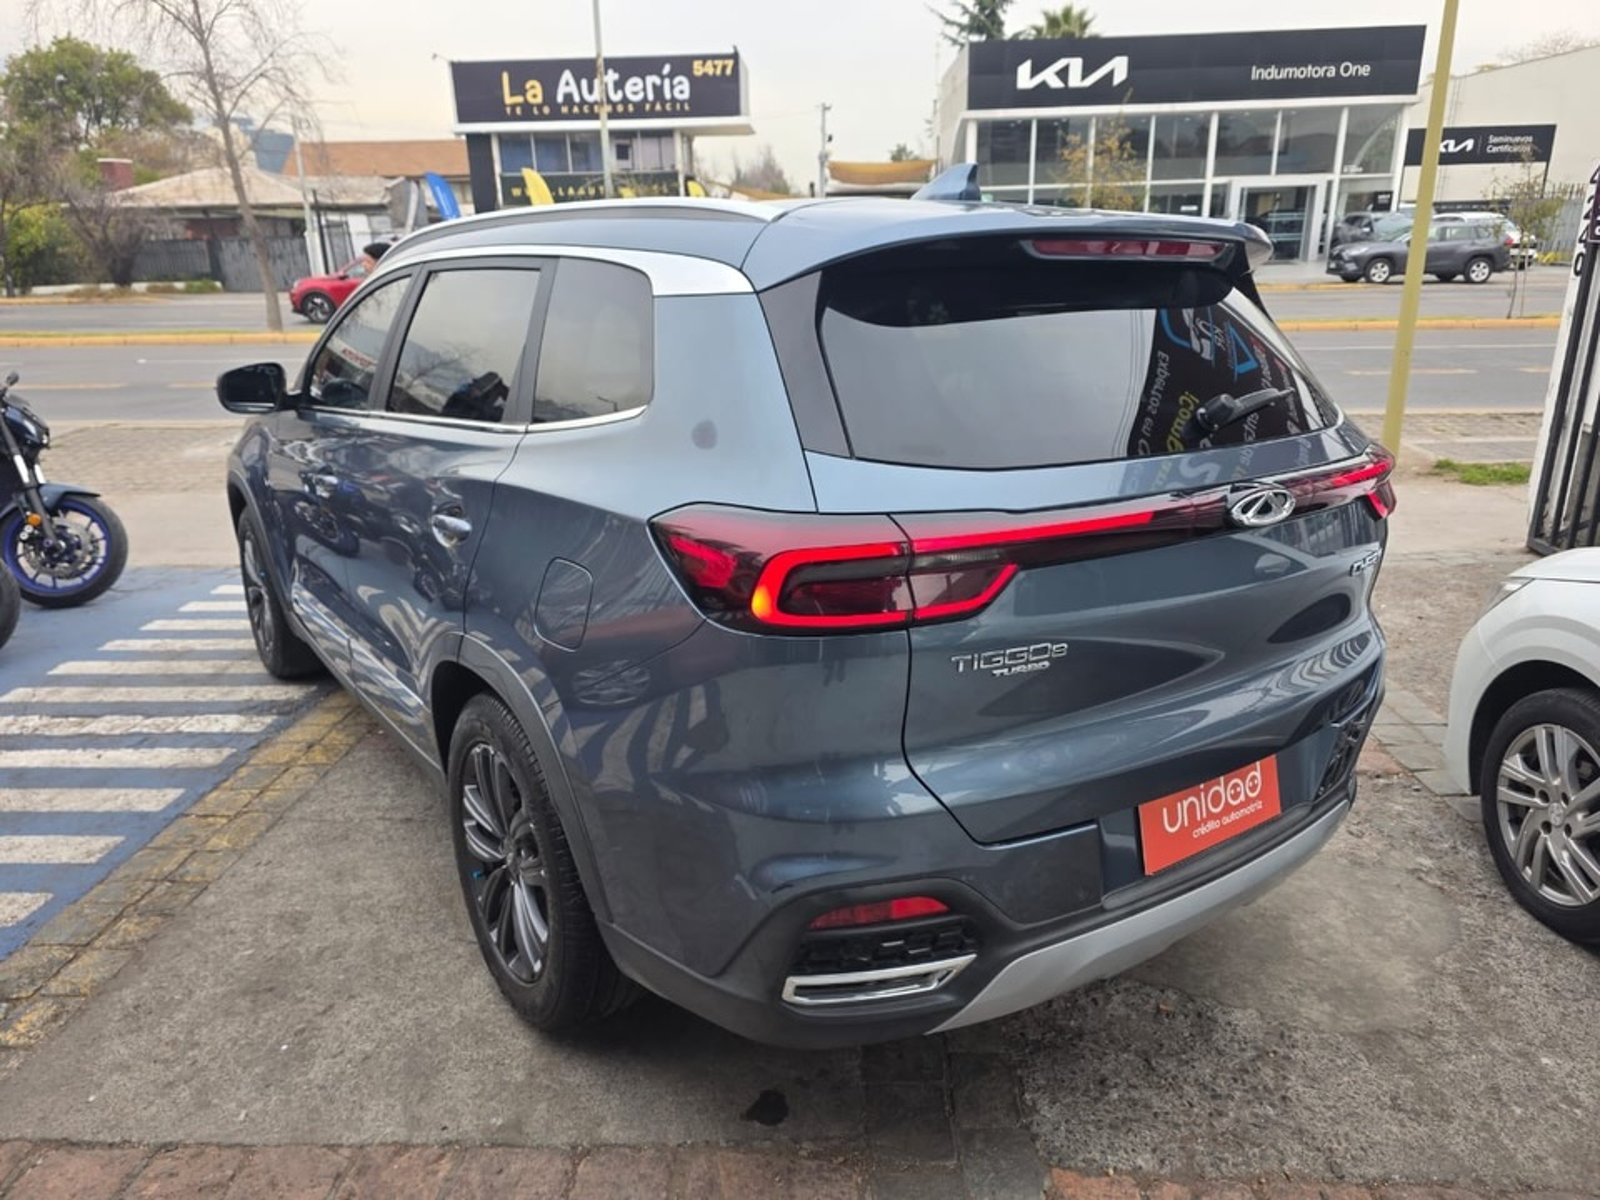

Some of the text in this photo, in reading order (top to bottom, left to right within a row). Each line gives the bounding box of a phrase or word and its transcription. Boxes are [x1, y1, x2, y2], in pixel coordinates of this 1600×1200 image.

[692, 59, 734, 76] 5477
[1016, 55, 1129, 90] KIA
[1251, 61, 1371, 80] Indumotora One
[502, 63, 690, 104] La Autería
[506, 105, 522, 115] TE
[532, 104, 550, 115] LO
[1488, 134, 1533, 143] Seminuevos
[992, 661, 1050, 676] TURBO
[1163, 761, 1262, 833] unidad
[1221, 800, 1263, 825] automotriz
